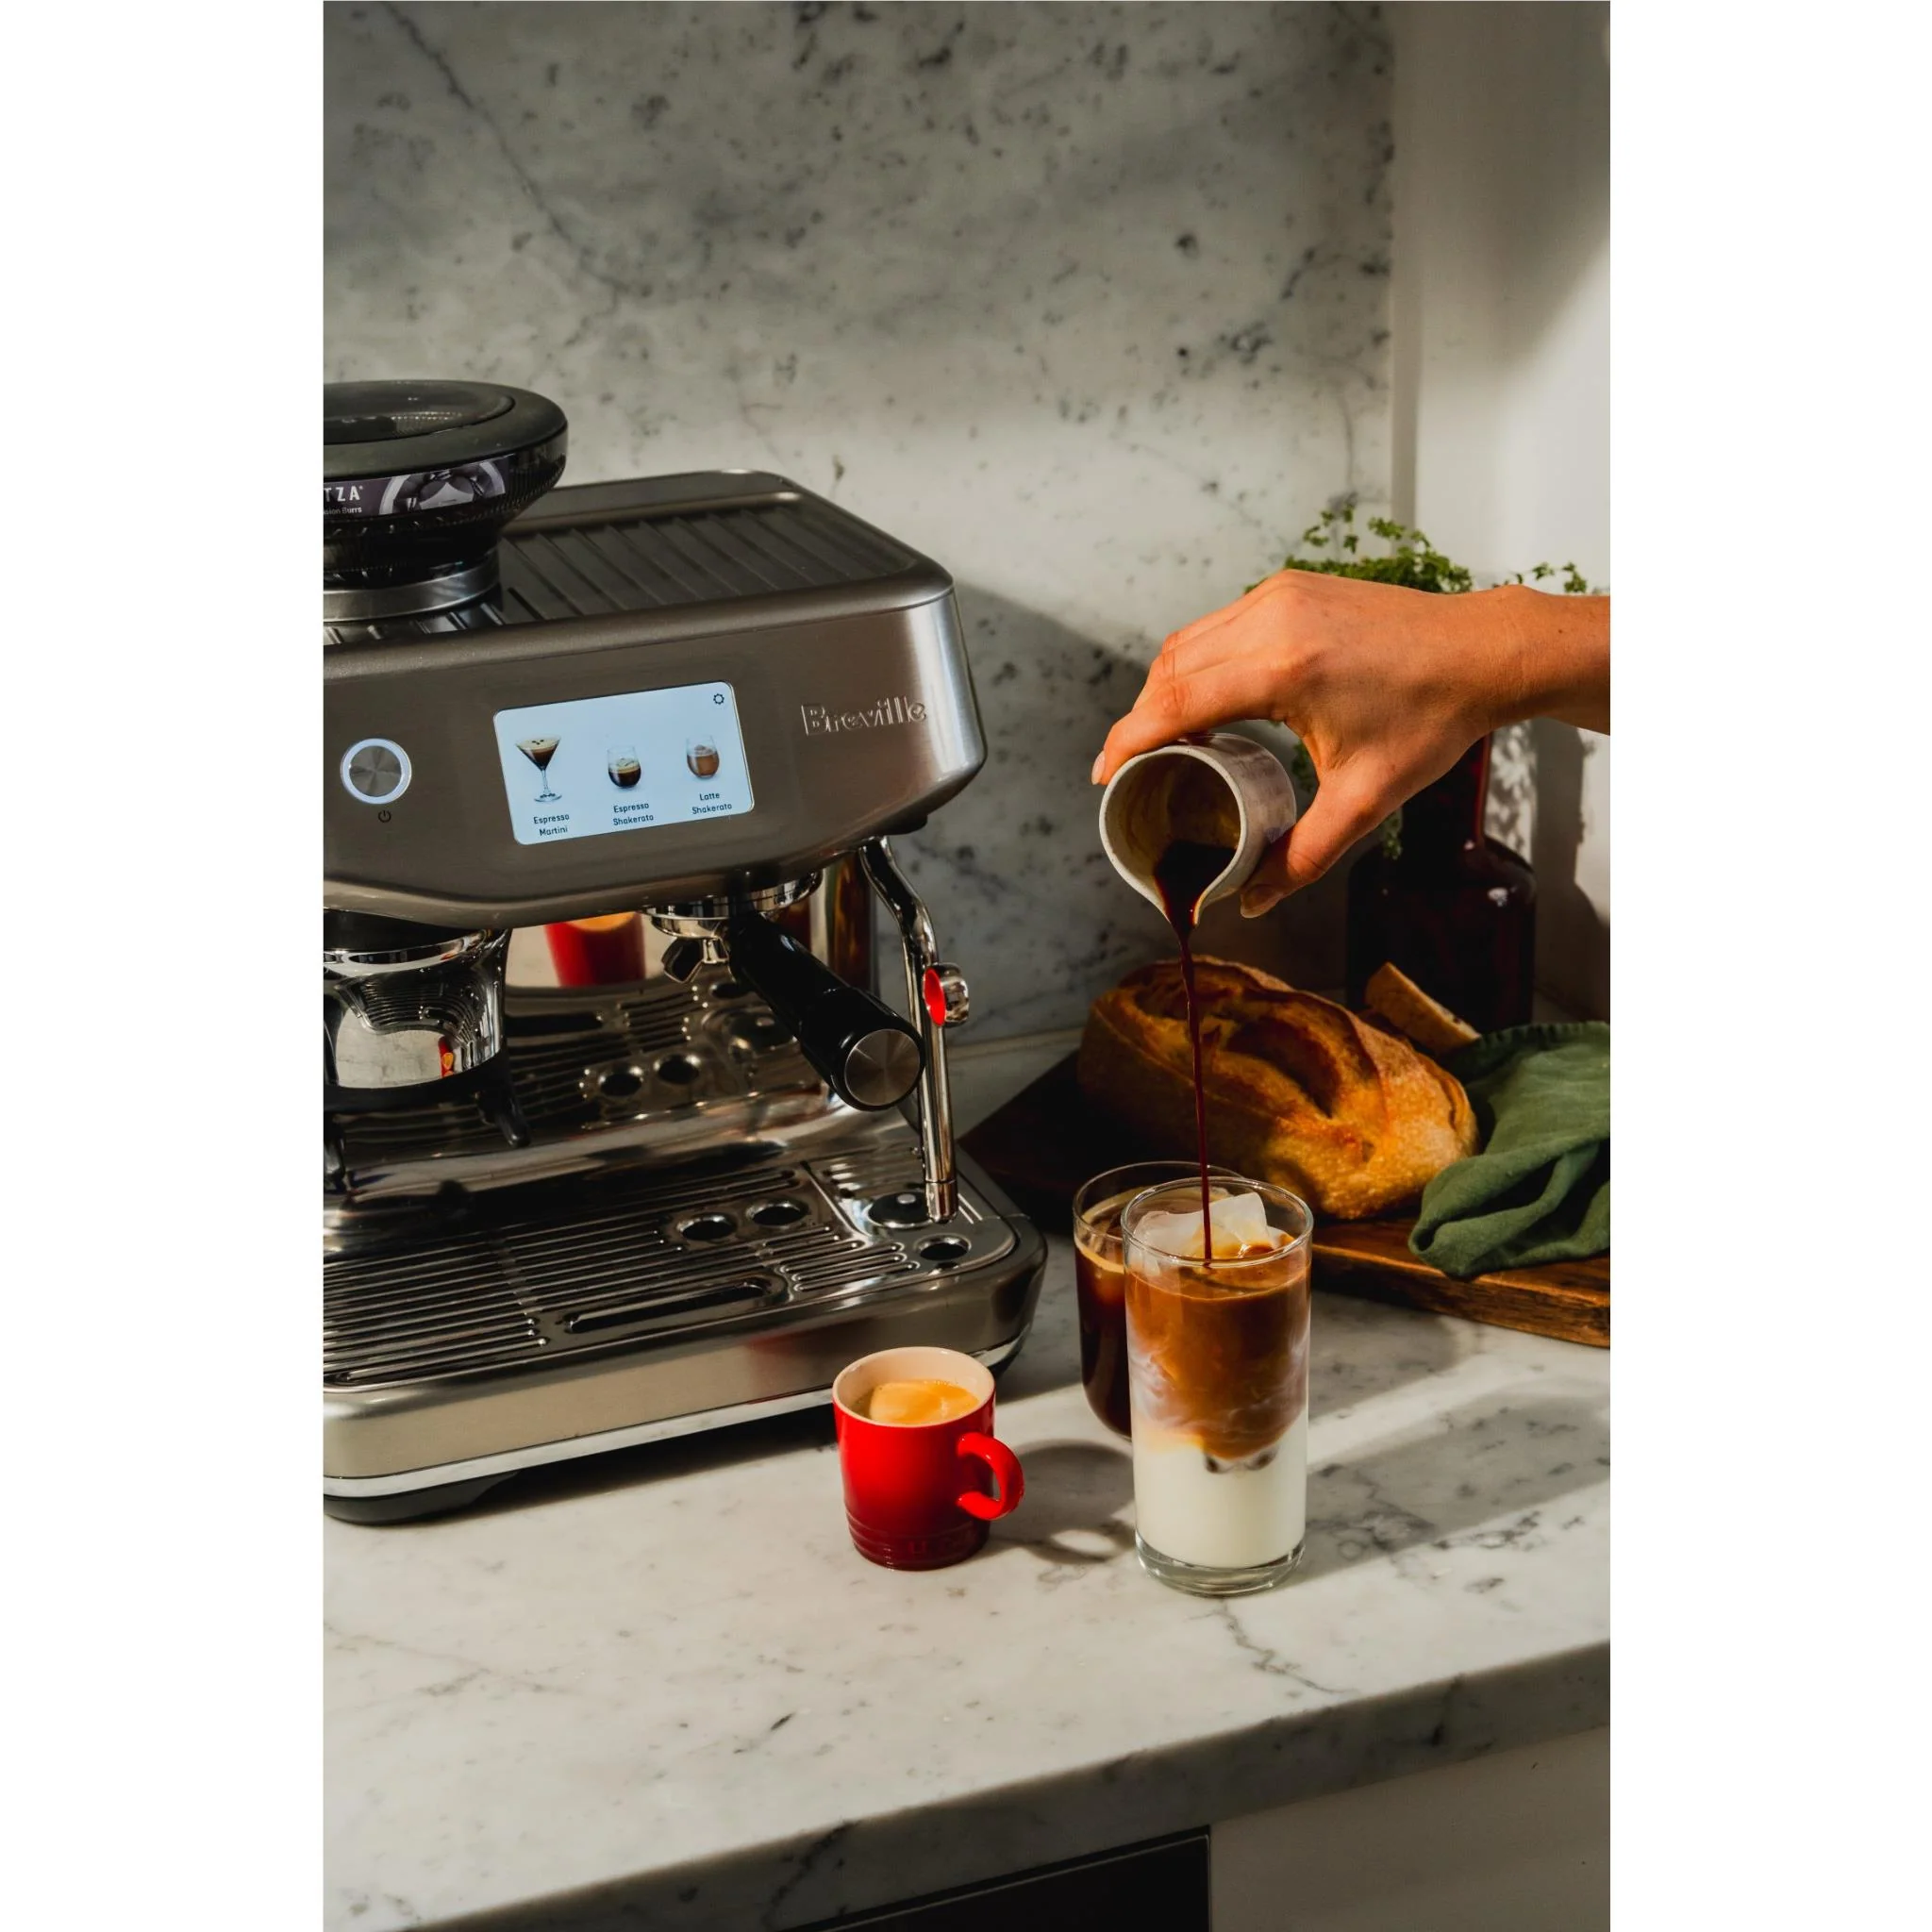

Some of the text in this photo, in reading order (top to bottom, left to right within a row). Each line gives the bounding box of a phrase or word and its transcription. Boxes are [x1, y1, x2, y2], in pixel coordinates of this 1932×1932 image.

[800, 696, 927, 736] Breville
[699, 792, 721, 801] Latte
[613, 802, 650, 813] Espresso
[691, 803, 733, 815] Shakerato
[533, 813, 570, 825] Espresso
[612, 813, 654, 826] Shakerato
[539, 825, 568, 837] Martini
